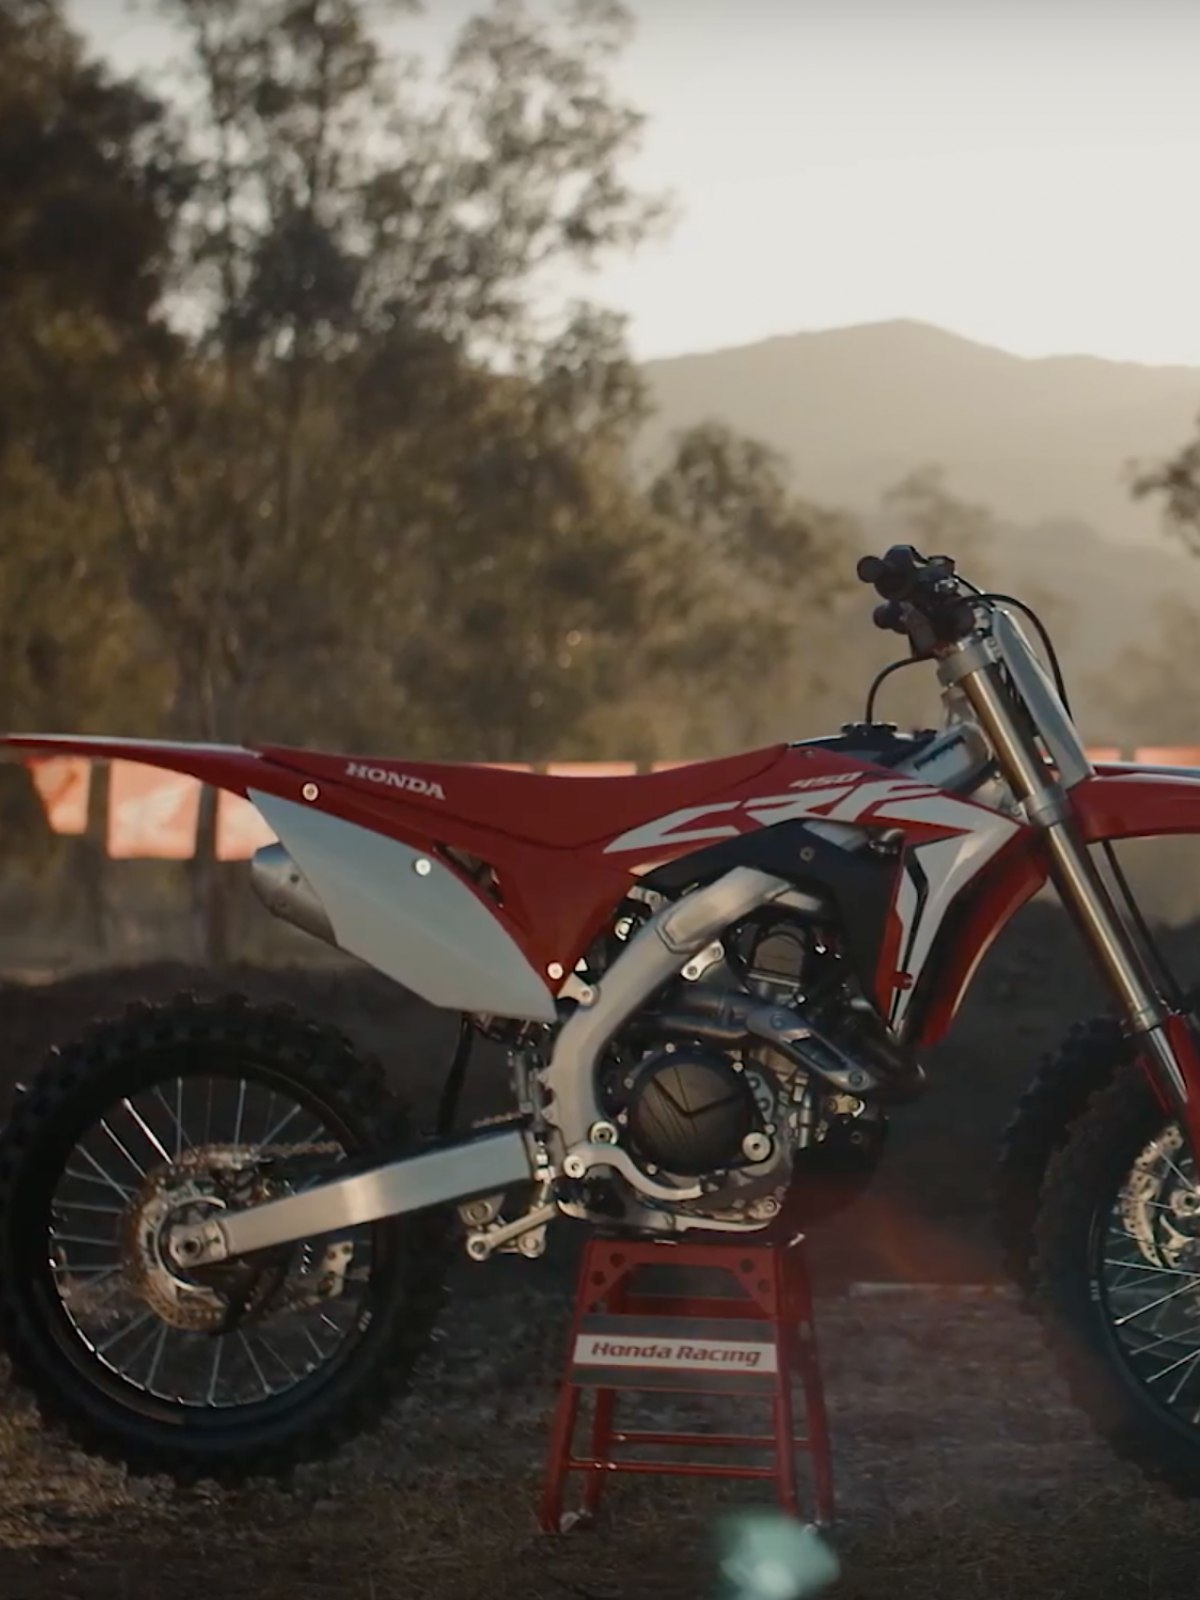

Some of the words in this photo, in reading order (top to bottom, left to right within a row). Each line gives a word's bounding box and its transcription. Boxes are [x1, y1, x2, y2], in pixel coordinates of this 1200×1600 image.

[344, 762, 446, 801] HONDA
[602, 779, 944, 855] CRF
[592, 1342, 671, 1359] Honda
[676, 1345, 762, 1367] Racing
